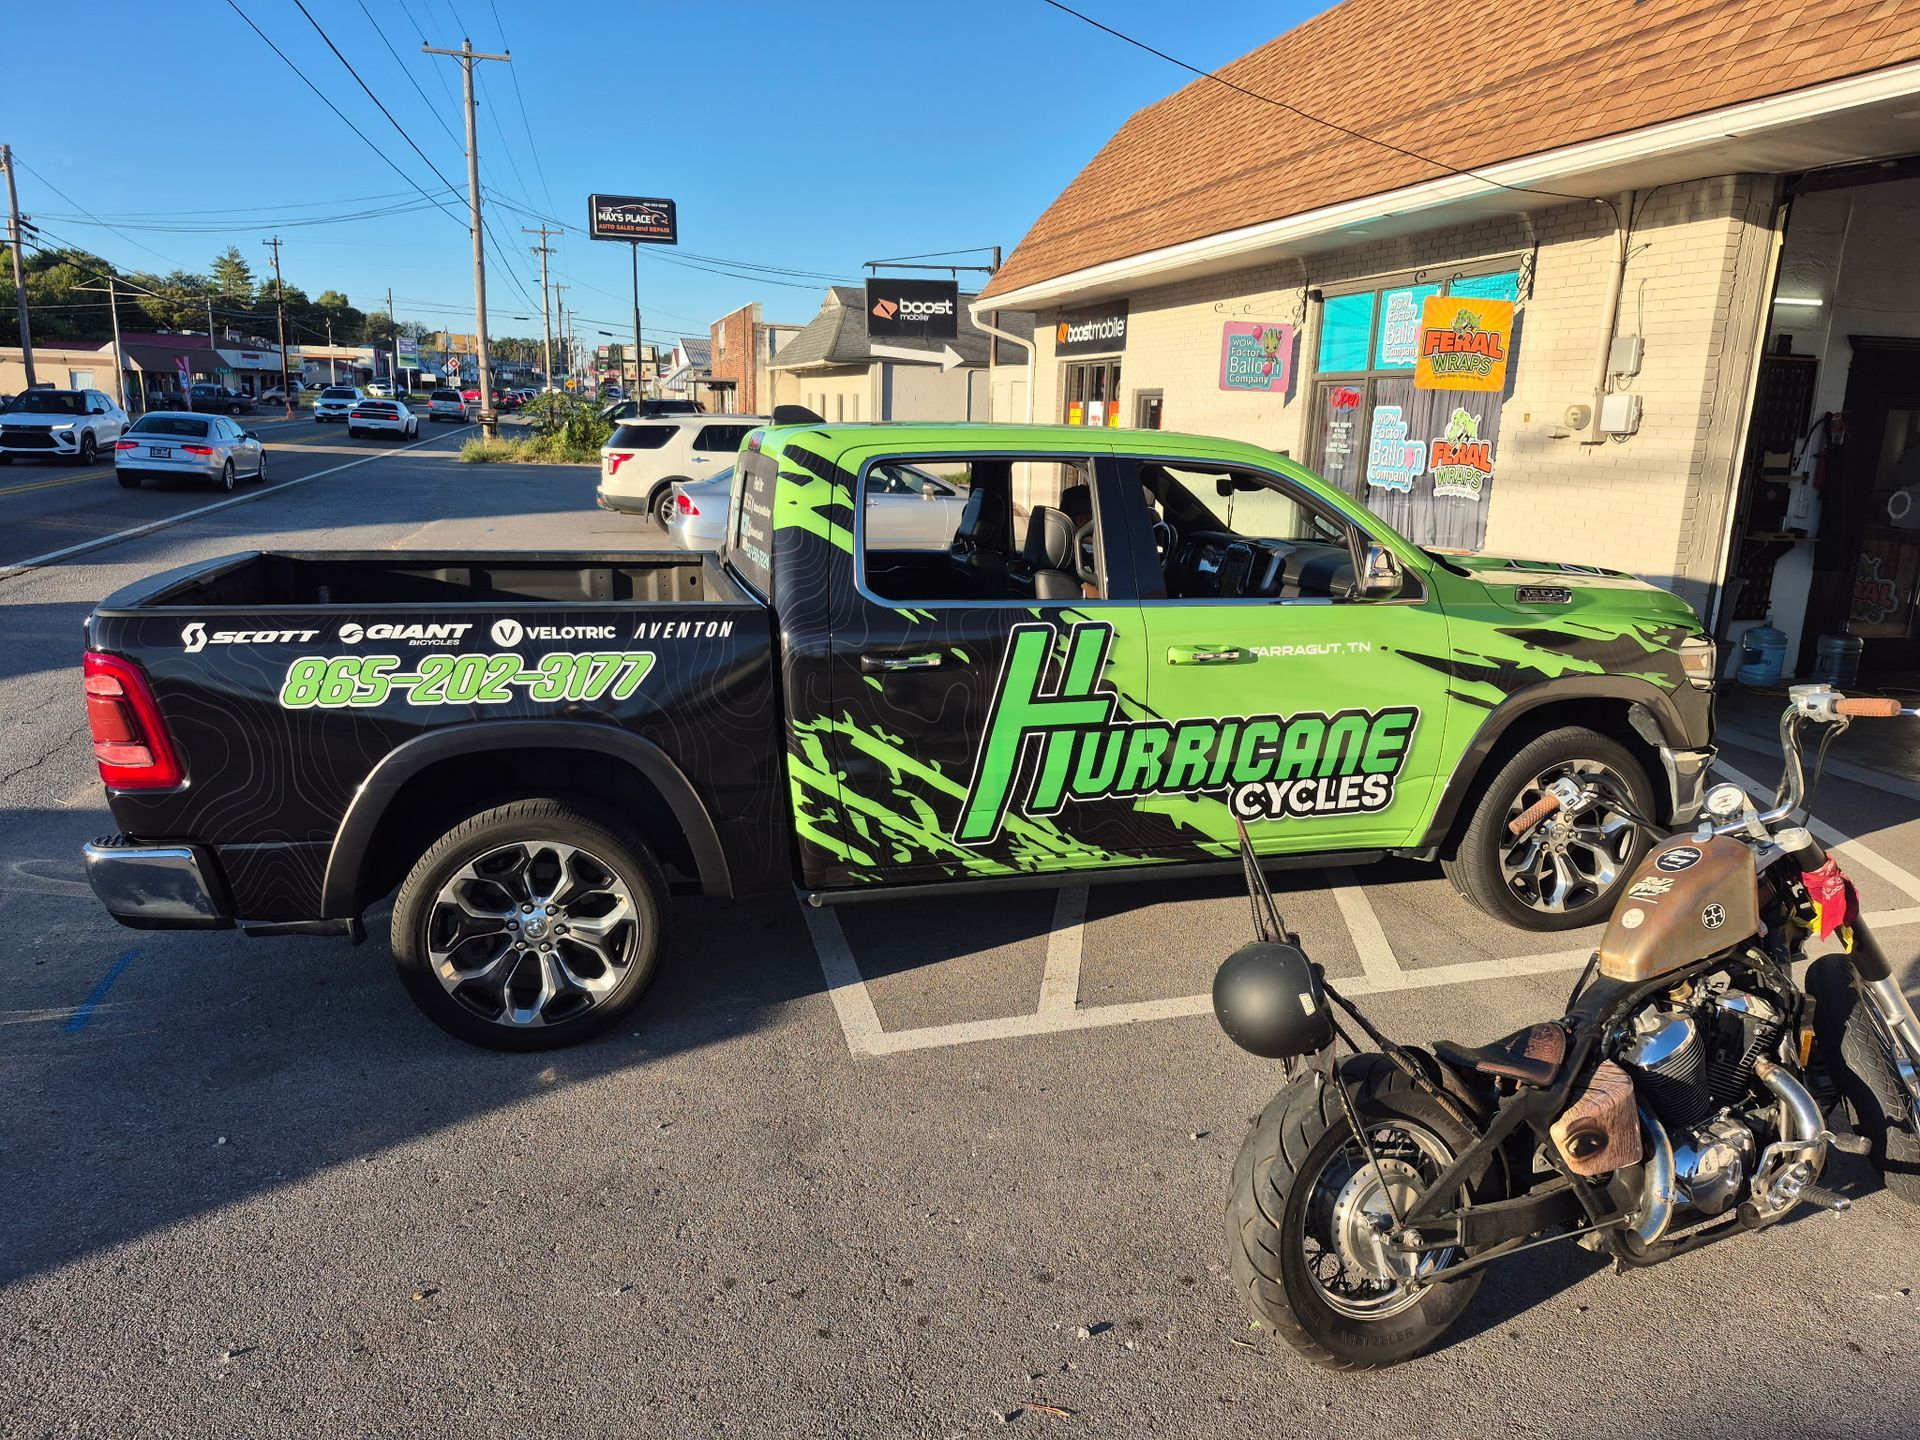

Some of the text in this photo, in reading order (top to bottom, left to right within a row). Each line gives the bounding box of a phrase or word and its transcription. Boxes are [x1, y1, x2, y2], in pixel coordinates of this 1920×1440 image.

[598, 212, 651, 224] MAX'S PLACE
[900, 298, 953, 315] boost
[1389, 310, 1414, 322] Factor
[1386, 322, 1416, 345] Ballo
[1233, 339, 1253, 347] WOW
[1422, 329, 1504, 360] FERAL
[1231, 348, 1259, 357] Factor
[1385, 346, 1416, 358] Compan
[1432, 354, 1492, 375] WRAPS
[1229, 374, 1268, 385] Company
[1331, 387, 1360, 408] Open
[1377, 413, 1399, 426] WOW
[1374, 426, 1403, 440] Factor
[1430, 441, 1493, 474] FERAL
[1370, 466, 1409, 485] Company
[1436, 466, 1482, 490] WRAPS
[208, 630, 321, 644] SCOTT
[366, 624, 473, 640] GIANT
[526, 626, 617, 640] VELOTRIC
[1347, 641, 1371, 653] TN
[279, 652, 656, 709] 865-202-3177
[954, 623, 1418, 844] HURRICANE
[1233, 773, 1391, 817] CYCLES
